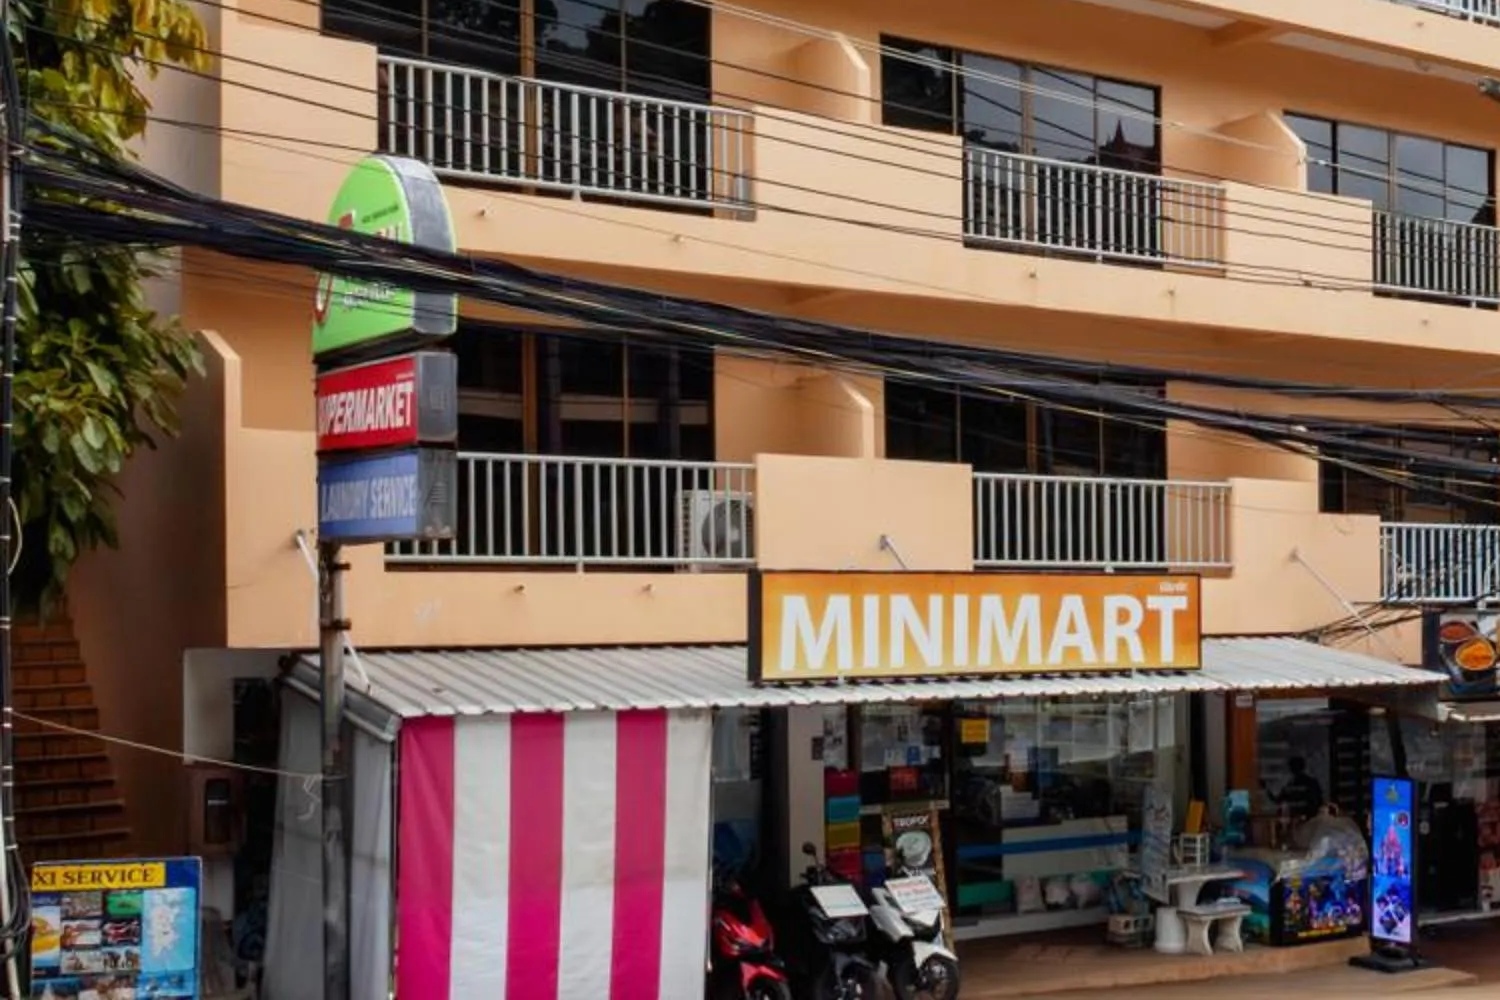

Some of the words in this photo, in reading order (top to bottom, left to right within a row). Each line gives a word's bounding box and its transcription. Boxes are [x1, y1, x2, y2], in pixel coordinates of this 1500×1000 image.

[371, 474, 417, 520] SERVICE
[779, 594, 1188, 672] MINIMART
[33, 871, 57, 886] XI
[63, 867, 155, 885] SERVICE
